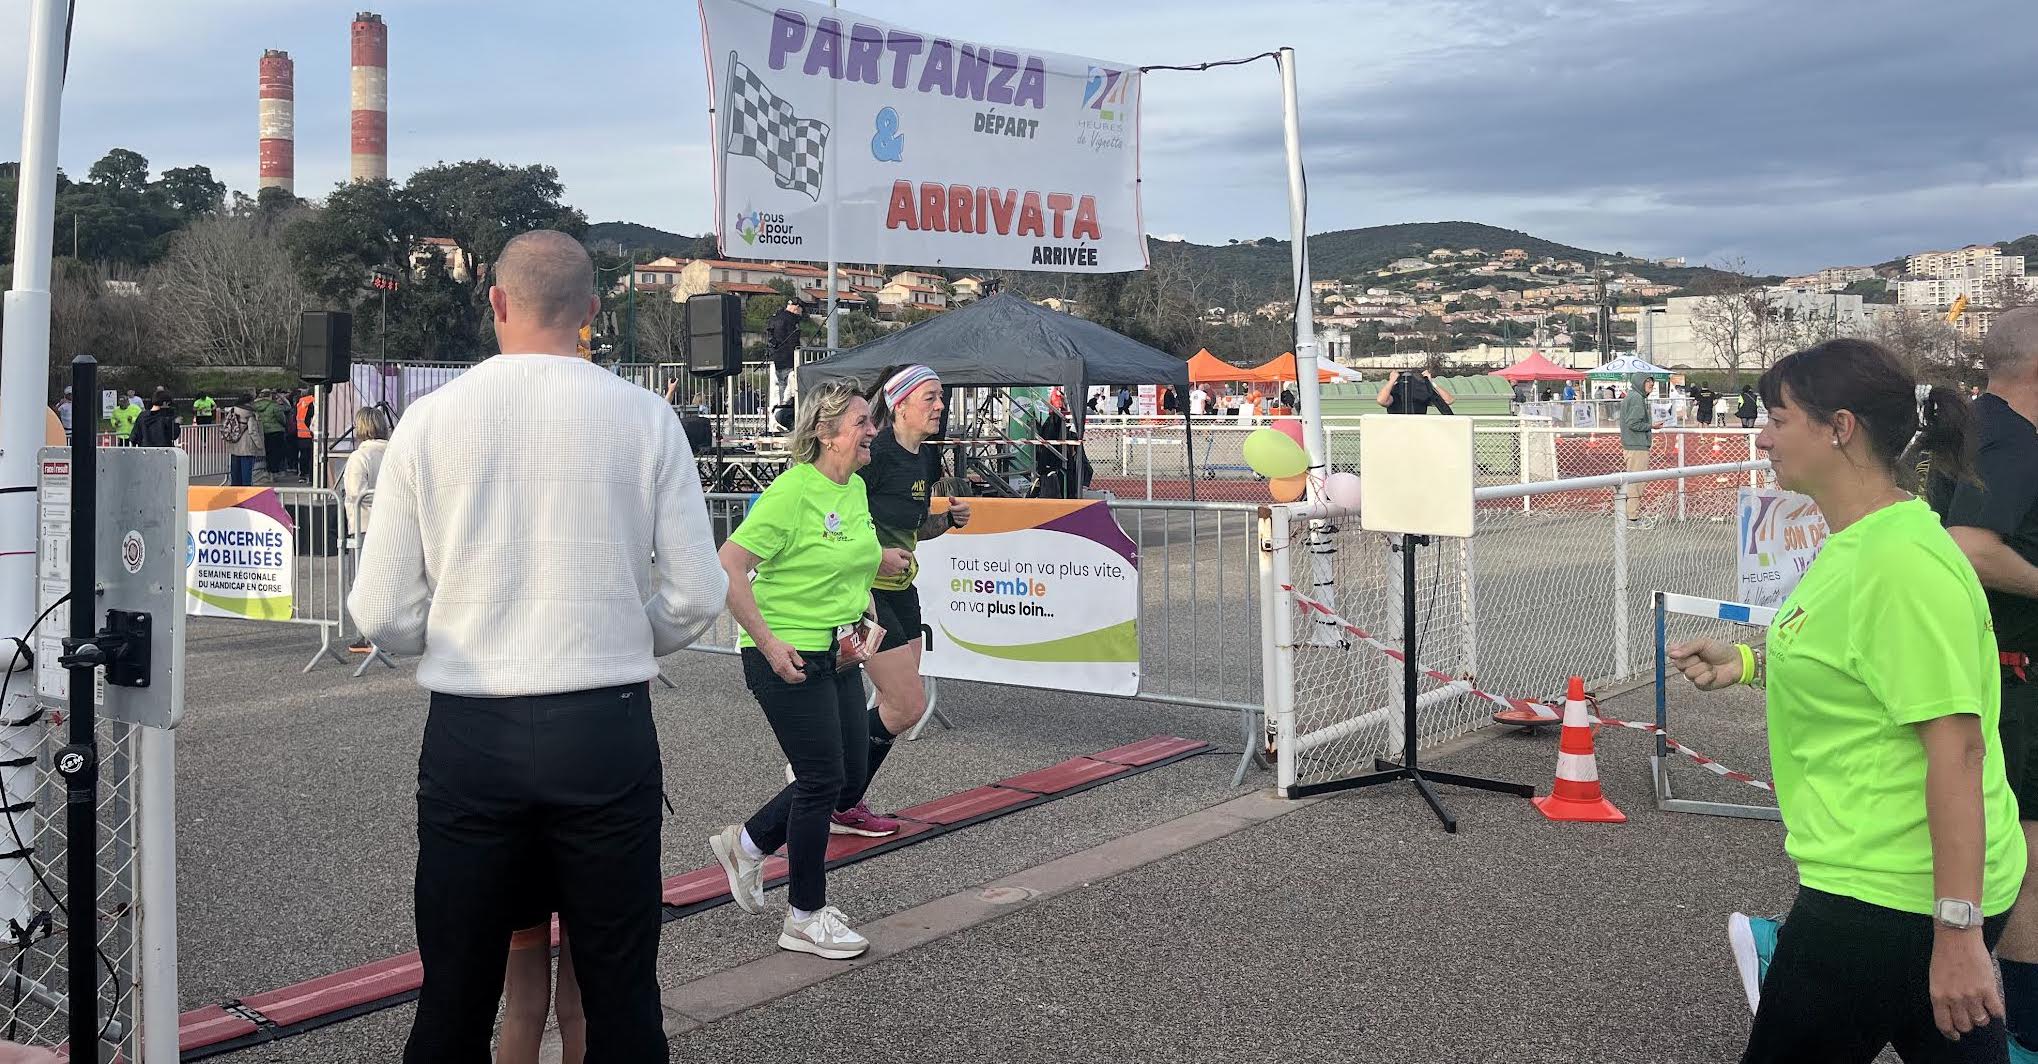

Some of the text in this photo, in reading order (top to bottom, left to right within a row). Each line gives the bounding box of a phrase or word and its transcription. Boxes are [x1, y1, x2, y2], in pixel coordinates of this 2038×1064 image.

[768, 8, 1047, 109] PARTANZA
[973, 108, 1039, 139] DÉPART
[1078, 119, 1123, 132] HEURES
[871, 106, 905, 162] &
[759, 211, 784, 223] tous
[886, 179, 1102, 240] ARRIVATA
[766, 224, 793, 236] pour
[759, 234, 803, 245] chacun
[1031, 242, 1098, 266] ARRIVÉE
[44, 464, 69, 473] race result
[198, 528, 283, 548] CONCERNÉS
[1783, 525, 1808, 551] SON
[198, 548, 283, 566] MOBILISÉS
[198, 569, 277, 582] SEMAINE RÉGIONALE
[950, 557, 1125, 581] Tout seul on va plus vite,
[1742, 571, 1781, 584] HEURES
[198, 580, 282, 592] DU HANDICAP EN CORSE
[950, 577, 1046, 597] ensemble
[950, 600, 1054, 618] on va plus loin...
